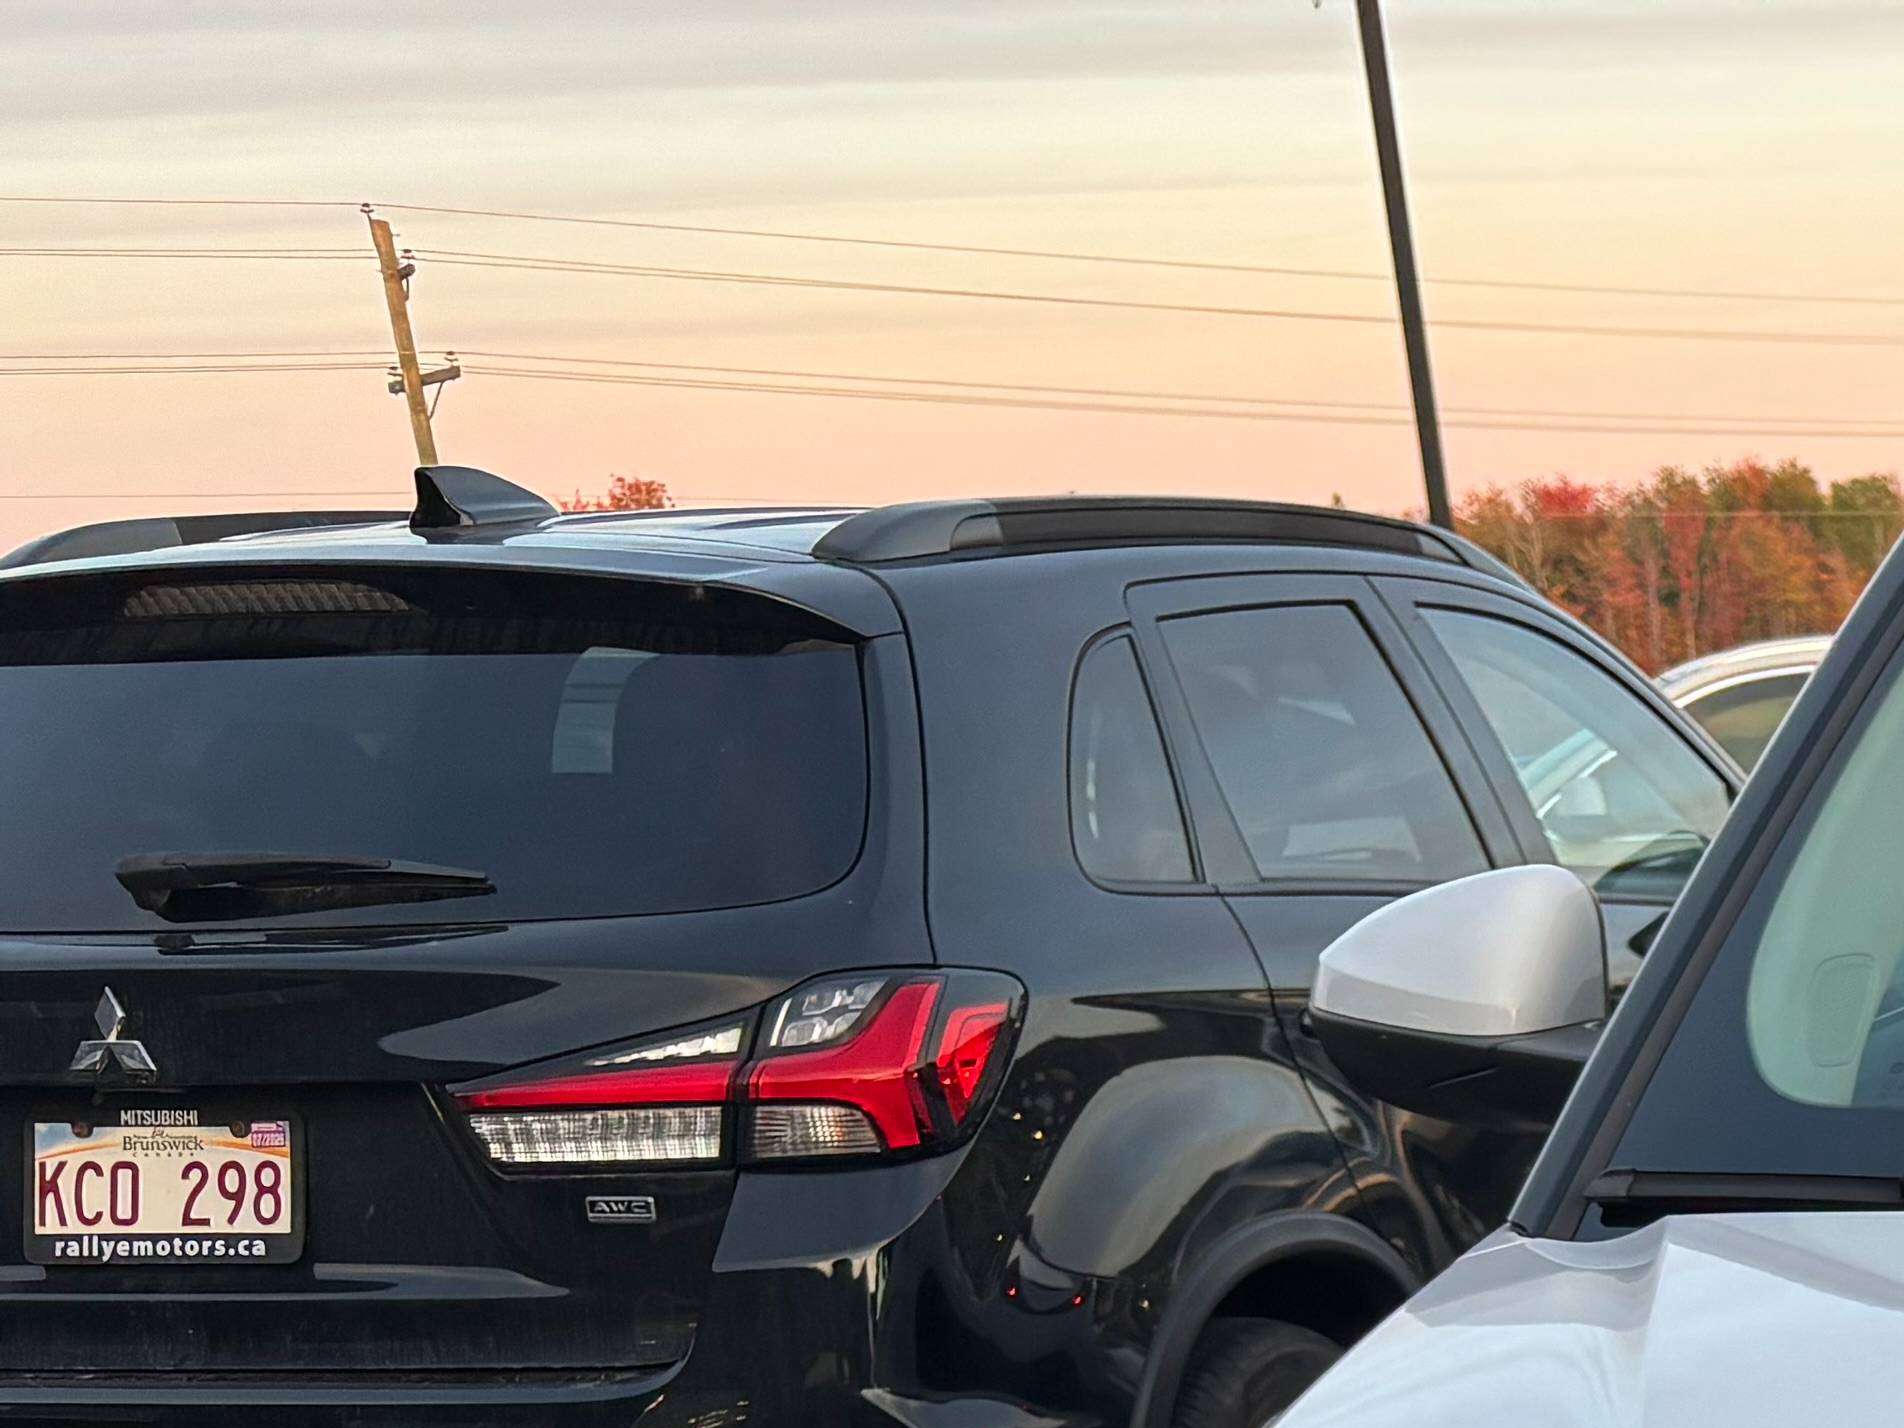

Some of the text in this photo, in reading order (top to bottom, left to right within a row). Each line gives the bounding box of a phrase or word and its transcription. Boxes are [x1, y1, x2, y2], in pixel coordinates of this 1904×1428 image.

[120, 1110, 198, 1126] MITSUBISHI
[122, 1134, 204, 1151] Brunswick
[181, 1160, 282, 1227] 298
[594, 1201, 647, 1213] AWC
[55, 1235, 266, 1262] rallyemotors.ca
